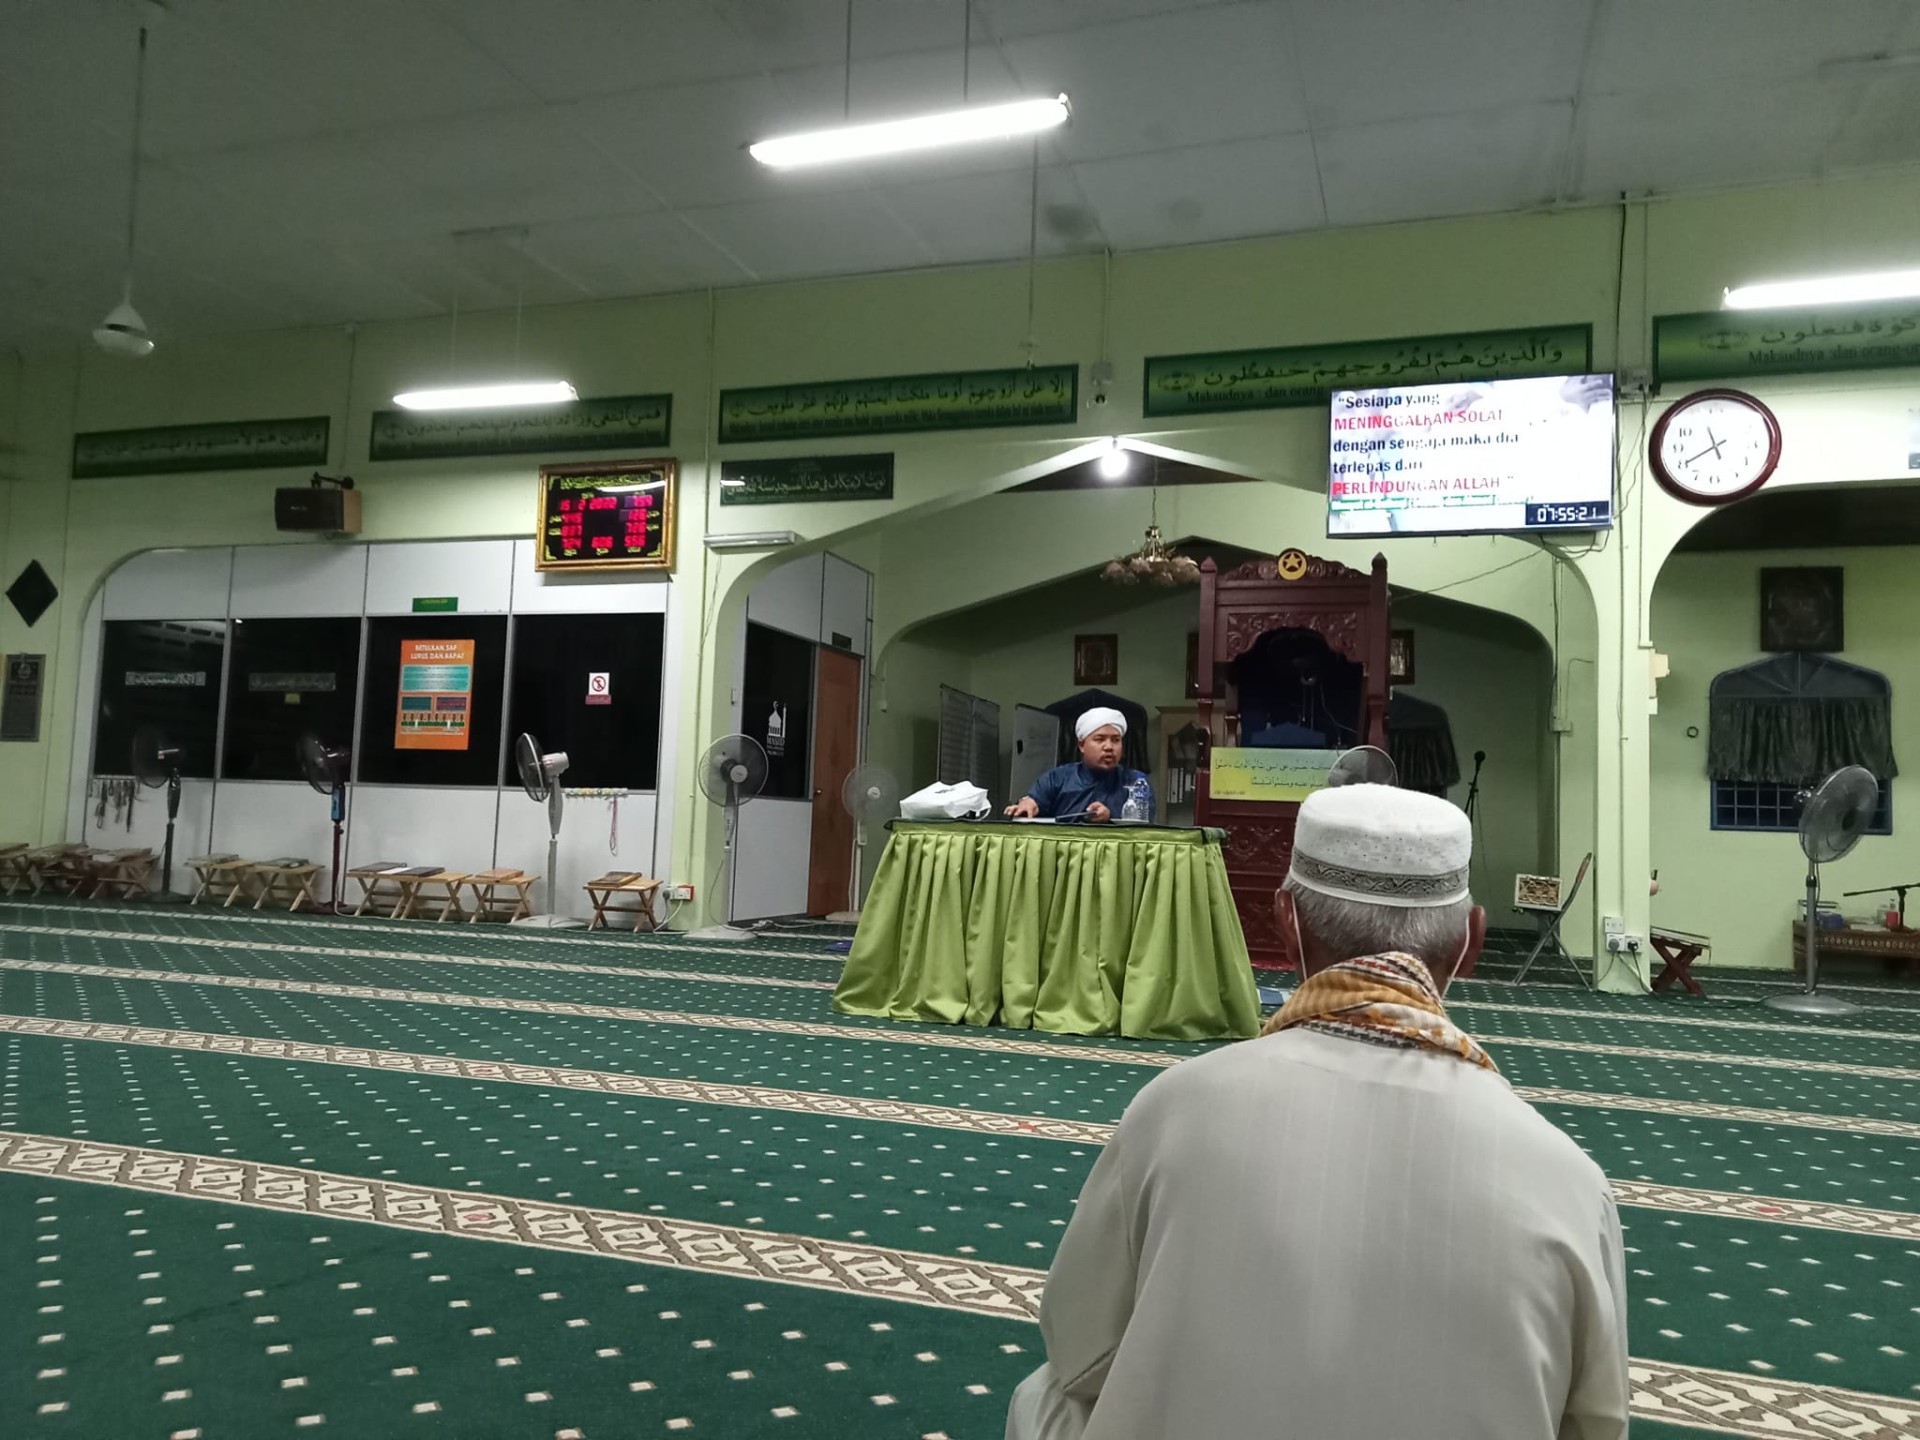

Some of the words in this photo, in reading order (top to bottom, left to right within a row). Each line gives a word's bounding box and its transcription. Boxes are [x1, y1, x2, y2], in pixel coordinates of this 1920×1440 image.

[1333, 439, 1386, 454] dengan
[1333, 461, 1391, 476] terlepas
[1332, 479, 1448, 496] PERLINDUNGAN
[1453, 476, 1500, 491] ALLAH
